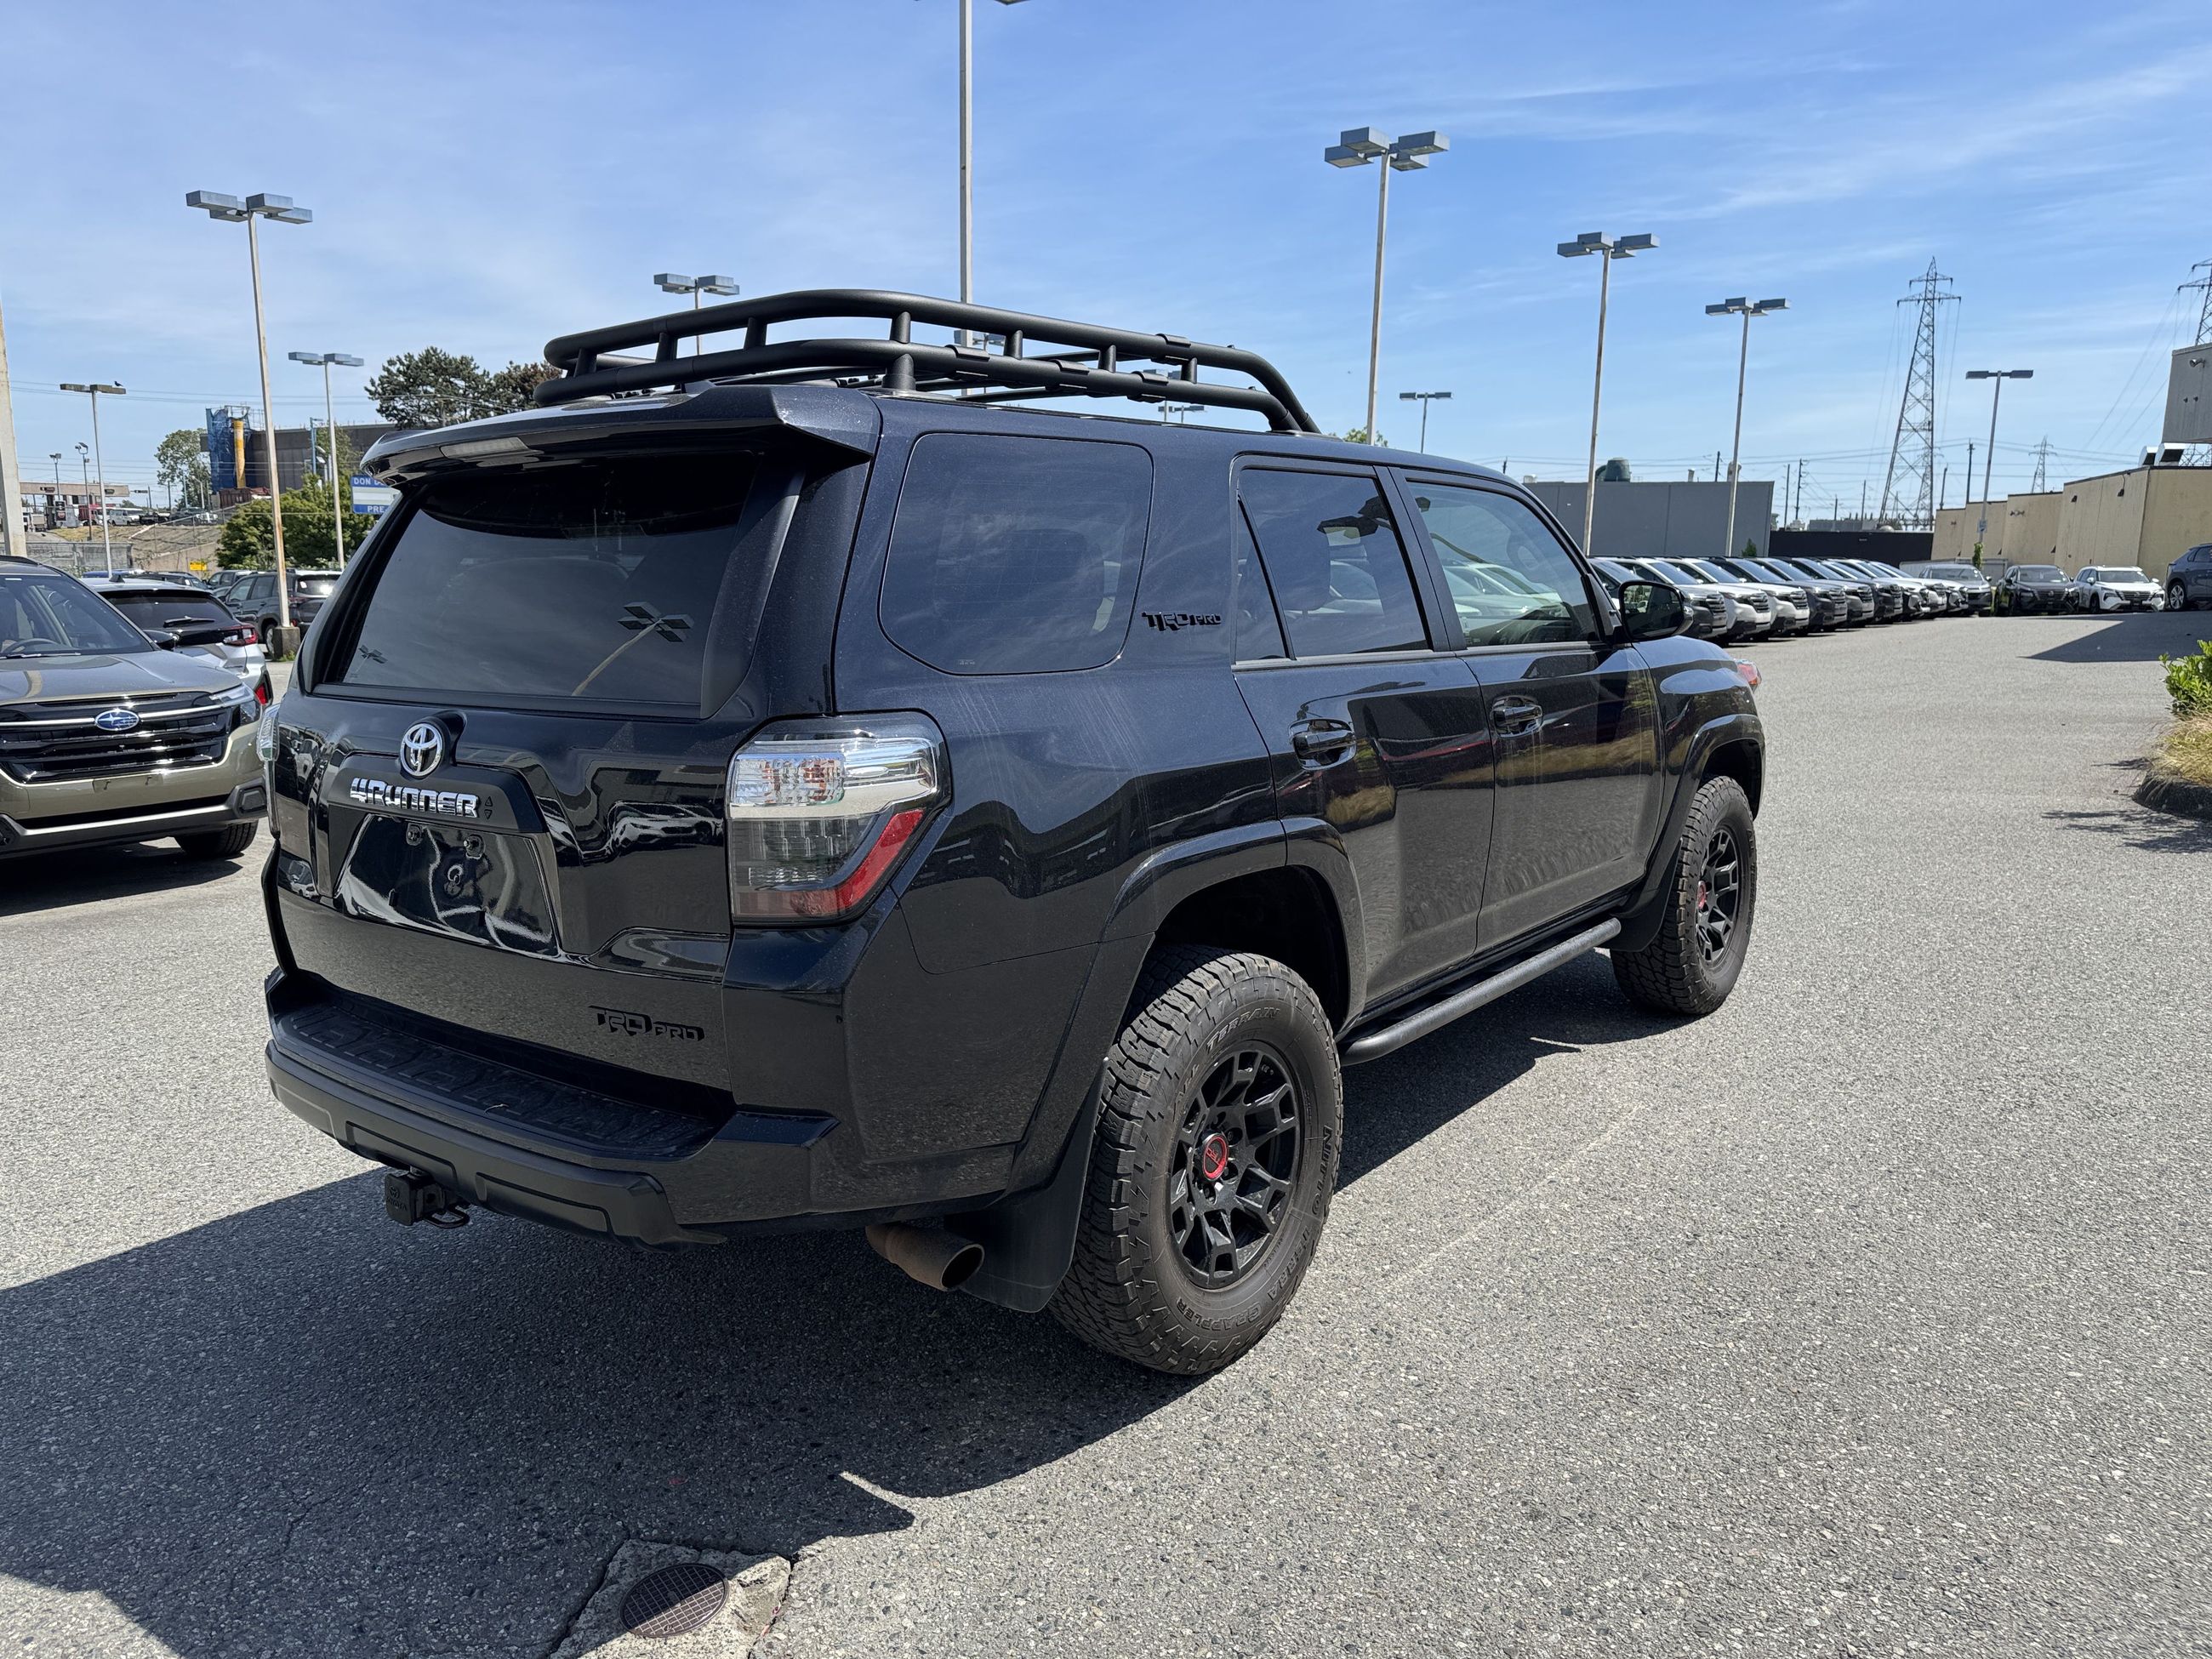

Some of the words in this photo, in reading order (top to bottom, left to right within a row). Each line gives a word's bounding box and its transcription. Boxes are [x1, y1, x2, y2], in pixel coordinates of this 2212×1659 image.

[1142, 612, 1189, 631] TRD
[1189, 613, 1223, 625] PRO
[350, 778, 480, 818] 4RUNNER
[588, 1005, 653, 1036] TRD
[652, 1021, 704, 1041] PRO
[1311, 1125, 1335, 1215] NITTO
[1177, 1296, 1263, 1331] GRAPPLER
